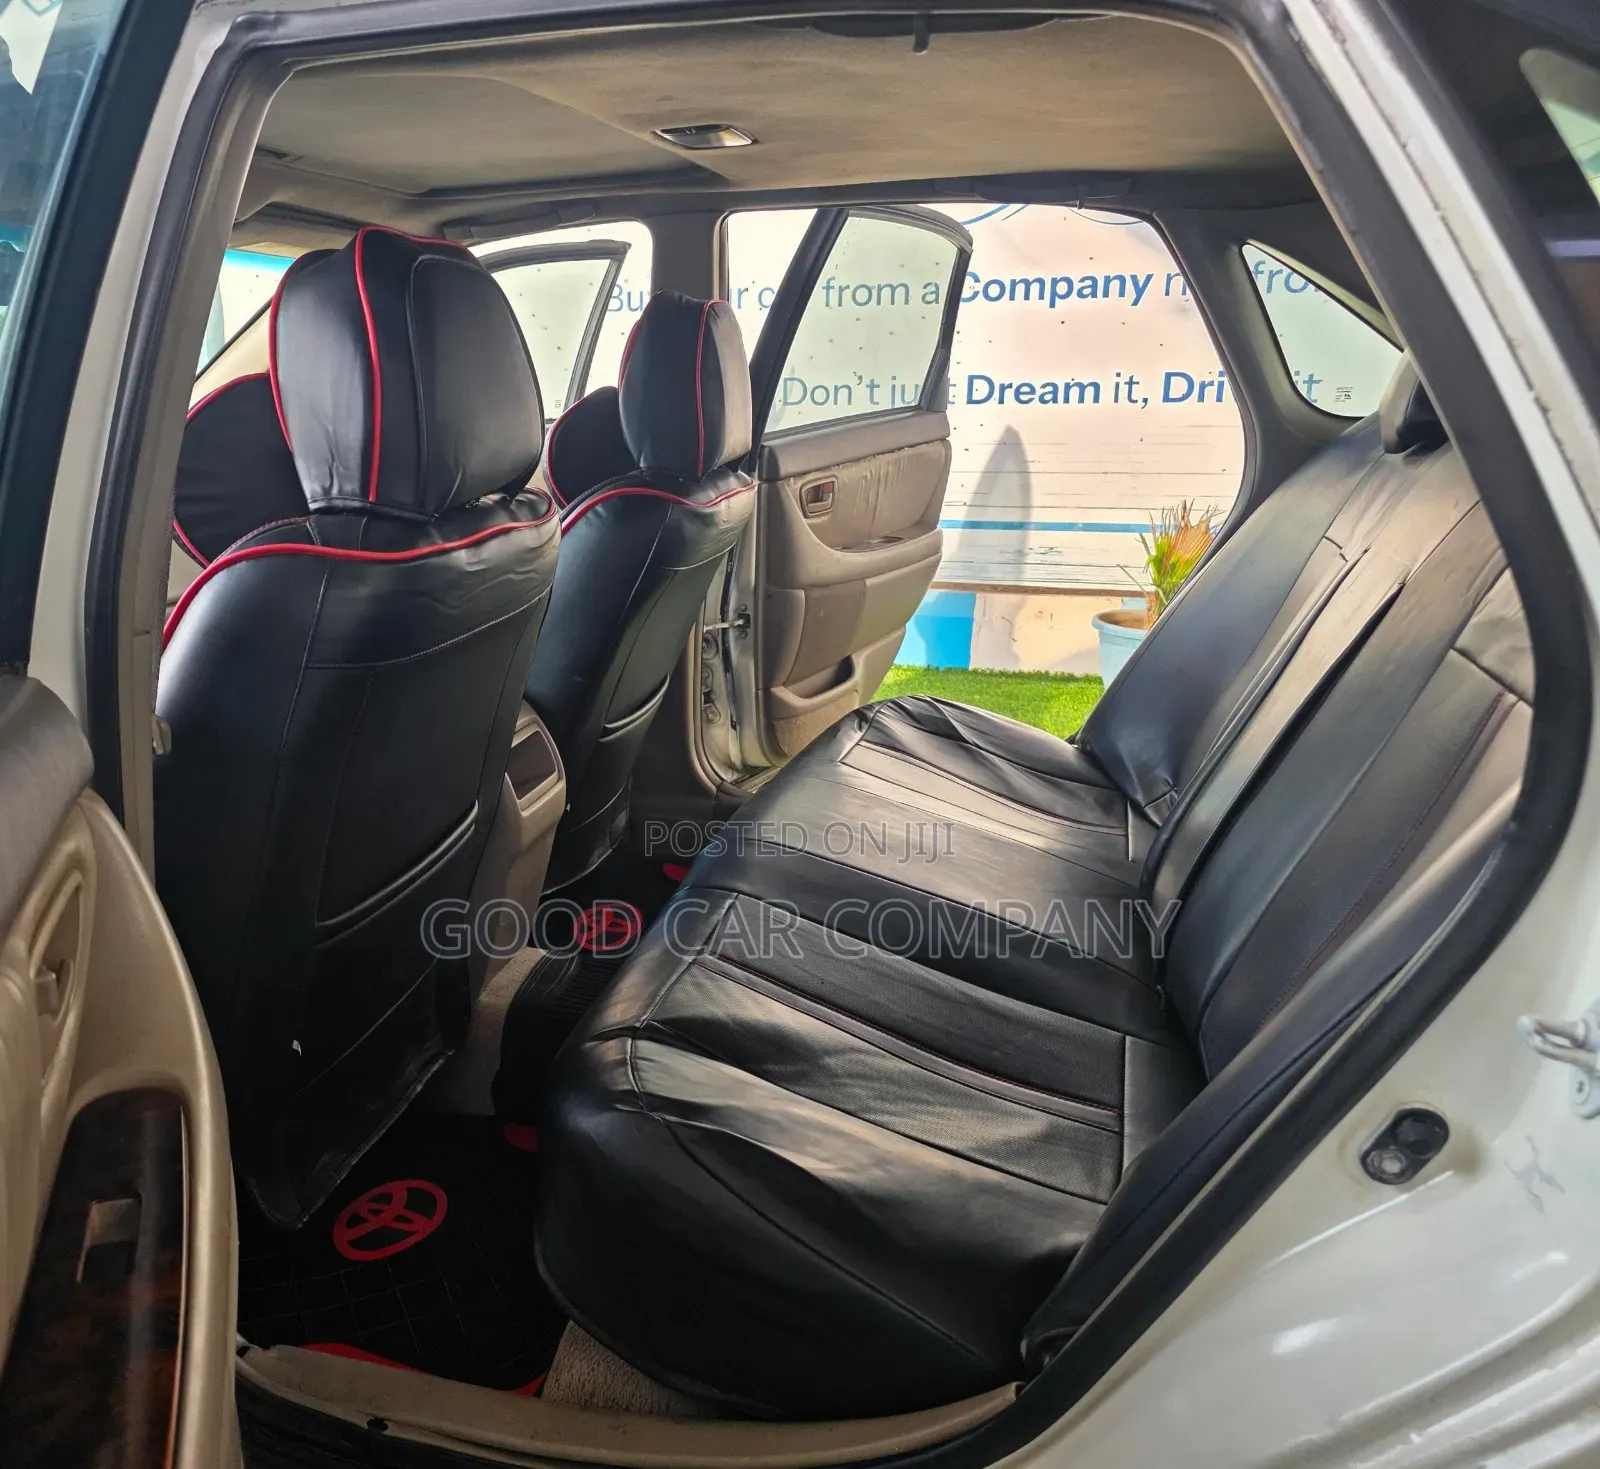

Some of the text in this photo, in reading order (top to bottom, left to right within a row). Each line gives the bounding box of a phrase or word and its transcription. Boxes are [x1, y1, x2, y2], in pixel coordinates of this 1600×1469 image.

[607, 283, 648, 313] Bu
[822, 276, 910, 308] from
[921, 282, 940, 305] a
[960, 271, 1154, 308] Company
[1252, 260, 1319, 294] fro
[890, 375, 956, 409] jut
[966, 374, 1101, 405] Dream
[1113, 372, 1148, 409] it,
[1162, 370, 1225, 404] Dri
